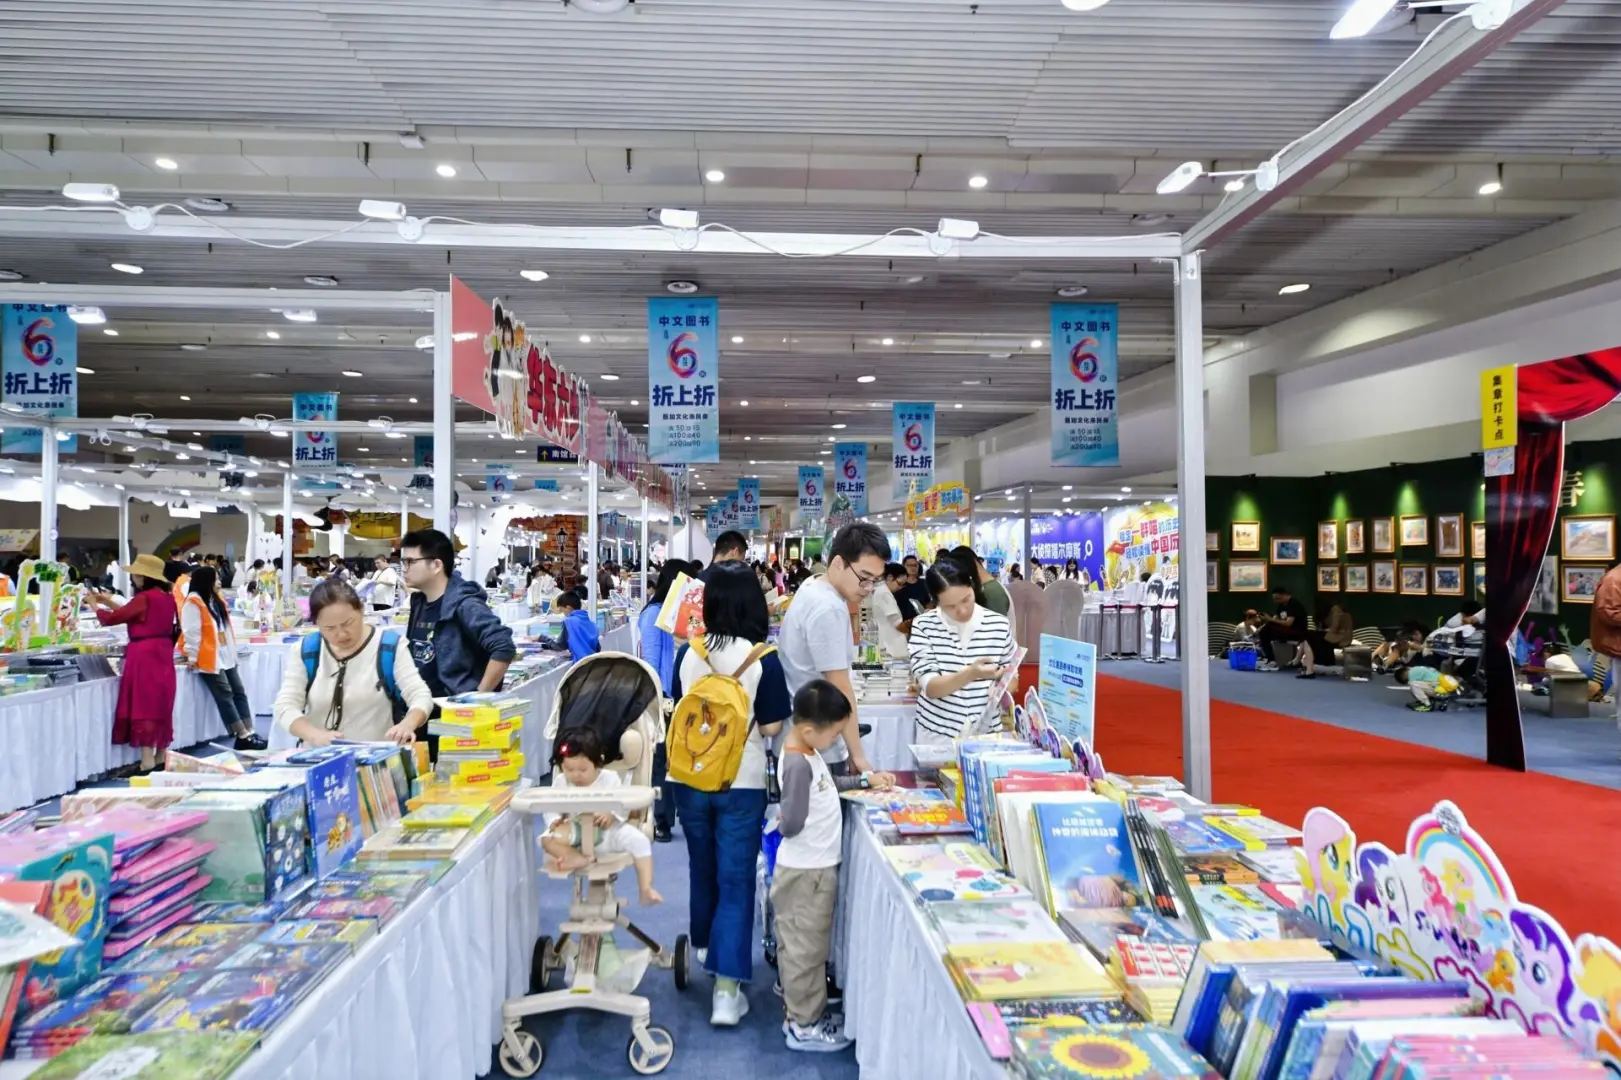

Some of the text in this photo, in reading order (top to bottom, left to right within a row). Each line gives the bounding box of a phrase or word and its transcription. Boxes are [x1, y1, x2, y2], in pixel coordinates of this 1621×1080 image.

[658, 315, 710, 327] 中文图书
[1061, 320, 1111, 332] 中文图书
[22, 317, 53, 367] 6
[667, 331, 699, 379] 6
[1070, 336, 1099, 383] 6
[5, 371, 72, 396] 折上折
[652, 384, 715, 407] 折上折
[1055, 388, 1116, 411] 折上折
[1492, 375, 1504, 440] 集章打卡点
[904, 423, 922, 452] 6
[295, 447, 336, 461] 折上折
[895, 454, 932, 469] 折上折
[843, 458, 857, 480] 6
[805, 479, 816, 497] 6
[836, 482, 865, 493] 折上折
[740, 505, 759, 513] 折上折
[800, 498, 823, 507] 折上折
